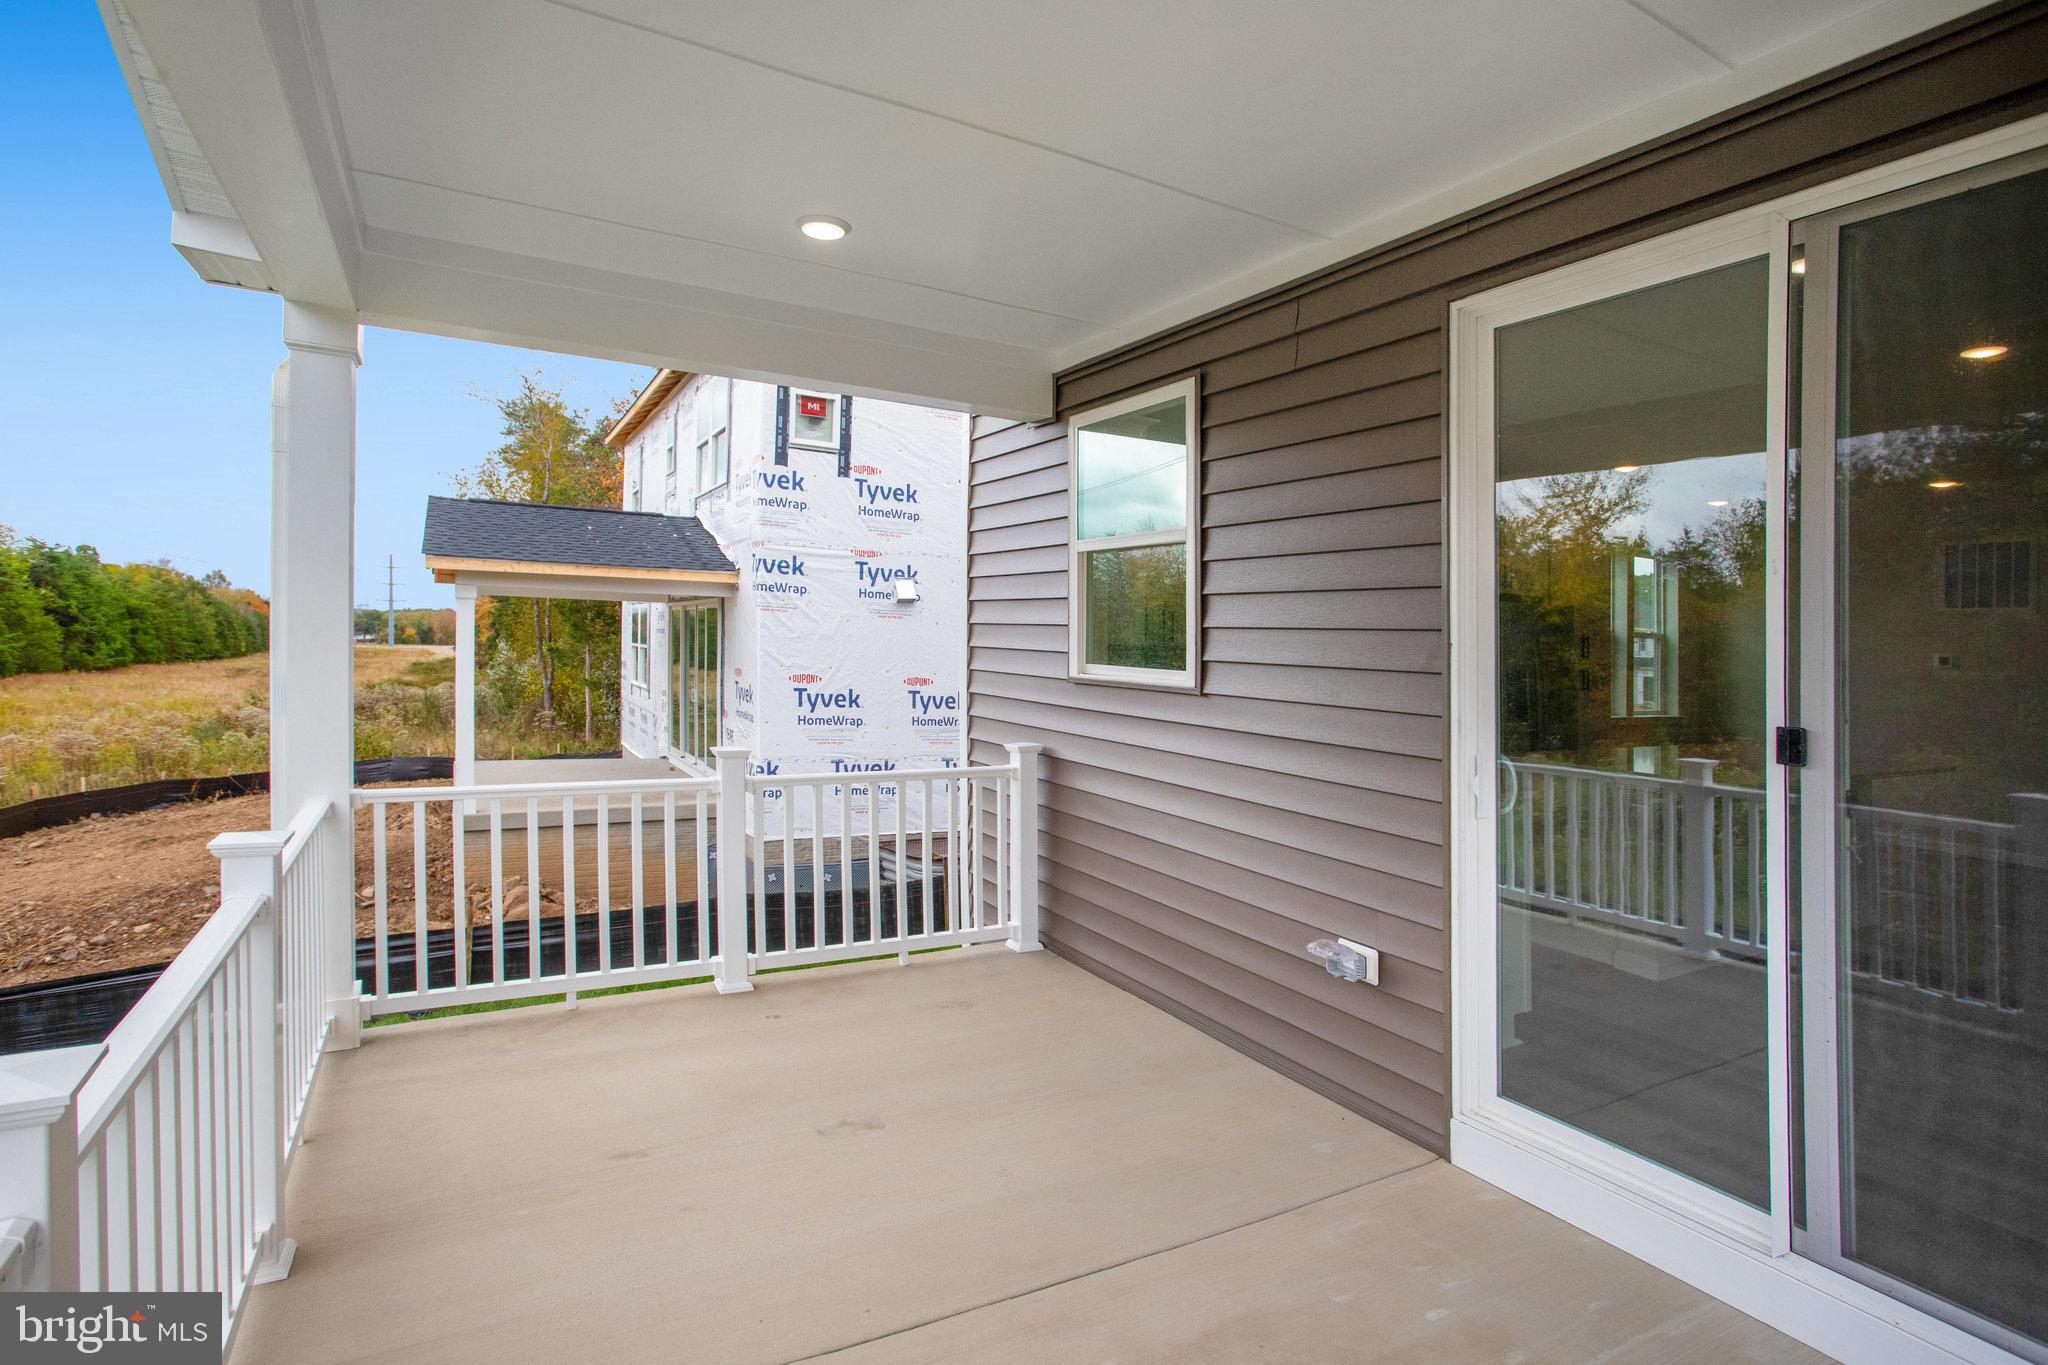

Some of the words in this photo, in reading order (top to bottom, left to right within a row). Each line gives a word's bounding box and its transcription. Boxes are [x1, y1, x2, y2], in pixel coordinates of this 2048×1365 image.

[854, 478, 918, 504] Tyvek
[757, 496, 807, 512] meWrap
[858, 505, 920, 522] HomeWrap
[792, 674, 818, 684] DUPONT
[906, 677, 931, 687] DUPONT
[793, 687, 861, 713] Tyvek
[908, 690, 960, 715] Tyve
[797, 715, 864, 728] HomeWrap
[912, 716, 960, 727] HomeWr
